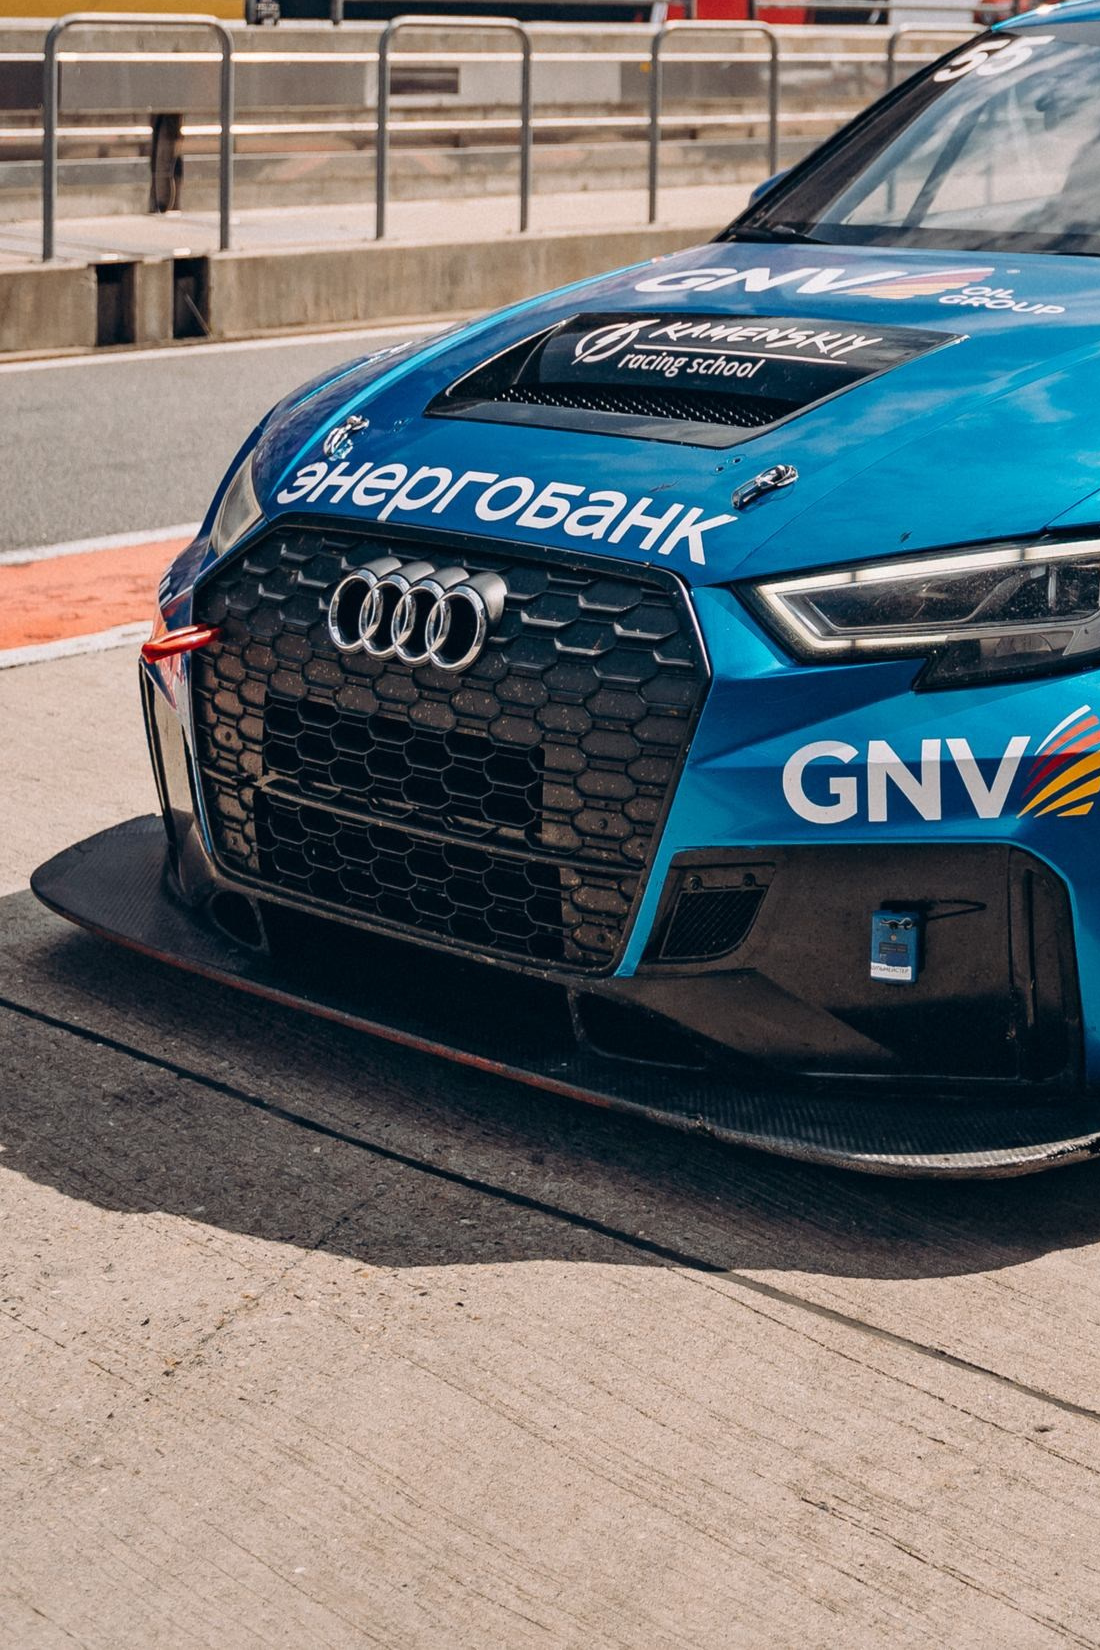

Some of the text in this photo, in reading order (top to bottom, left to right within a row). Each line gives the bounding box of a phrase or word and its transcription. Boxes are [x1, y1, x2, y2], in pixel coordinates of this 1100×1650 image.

[933, 35, 1056, 83] 55
[635, 267, 908, 293] GNV
[961, 285, 1013, 300] OIL
[938, 294, 1066, 316] GROUP
[648, 321, 884, 358] KAMENSKIY
[617, 351, 764, 379] racing school
[782, 736, 1031, 825] GNV
